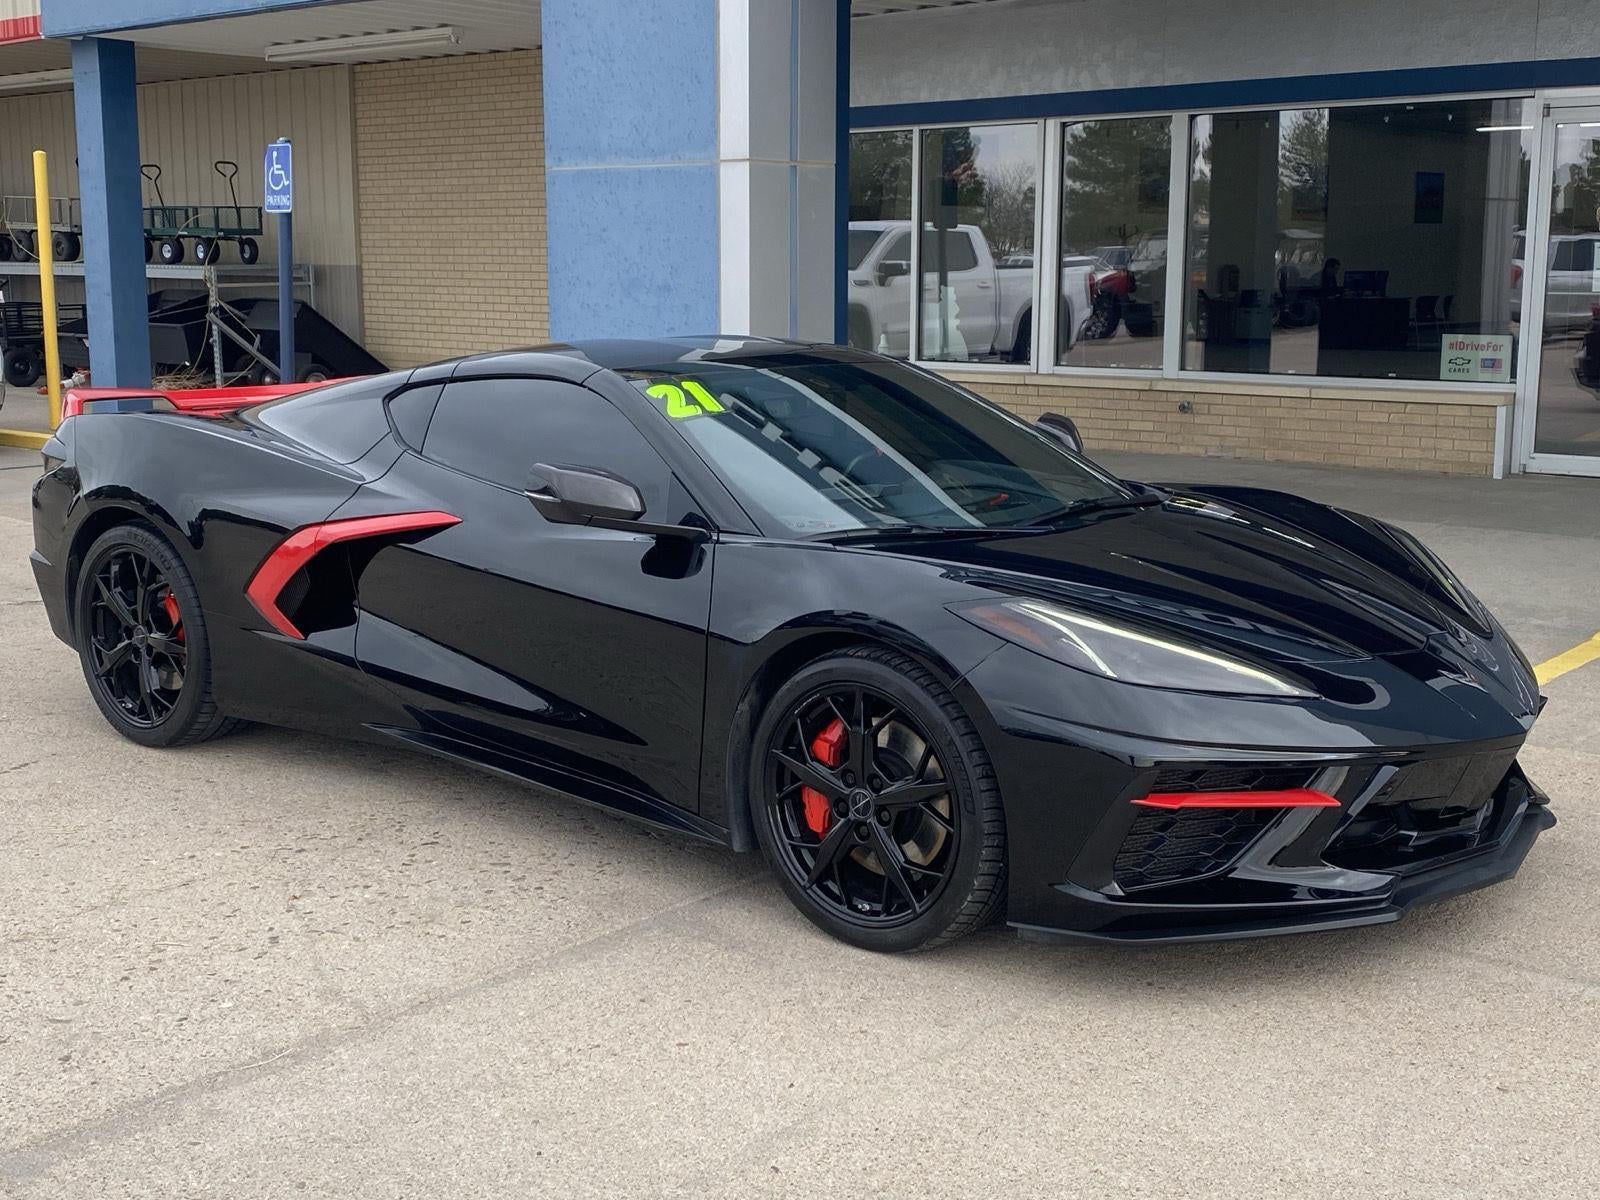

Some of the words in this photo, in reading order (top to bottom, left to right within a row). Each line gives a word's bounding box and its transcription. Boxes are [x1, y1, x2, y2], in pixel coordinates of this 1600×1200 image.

[266, 194, 290, 206] PARKING
[1448, 340, 1504, 352] #IDriveFor
[646, 381, 726, 418] 21
